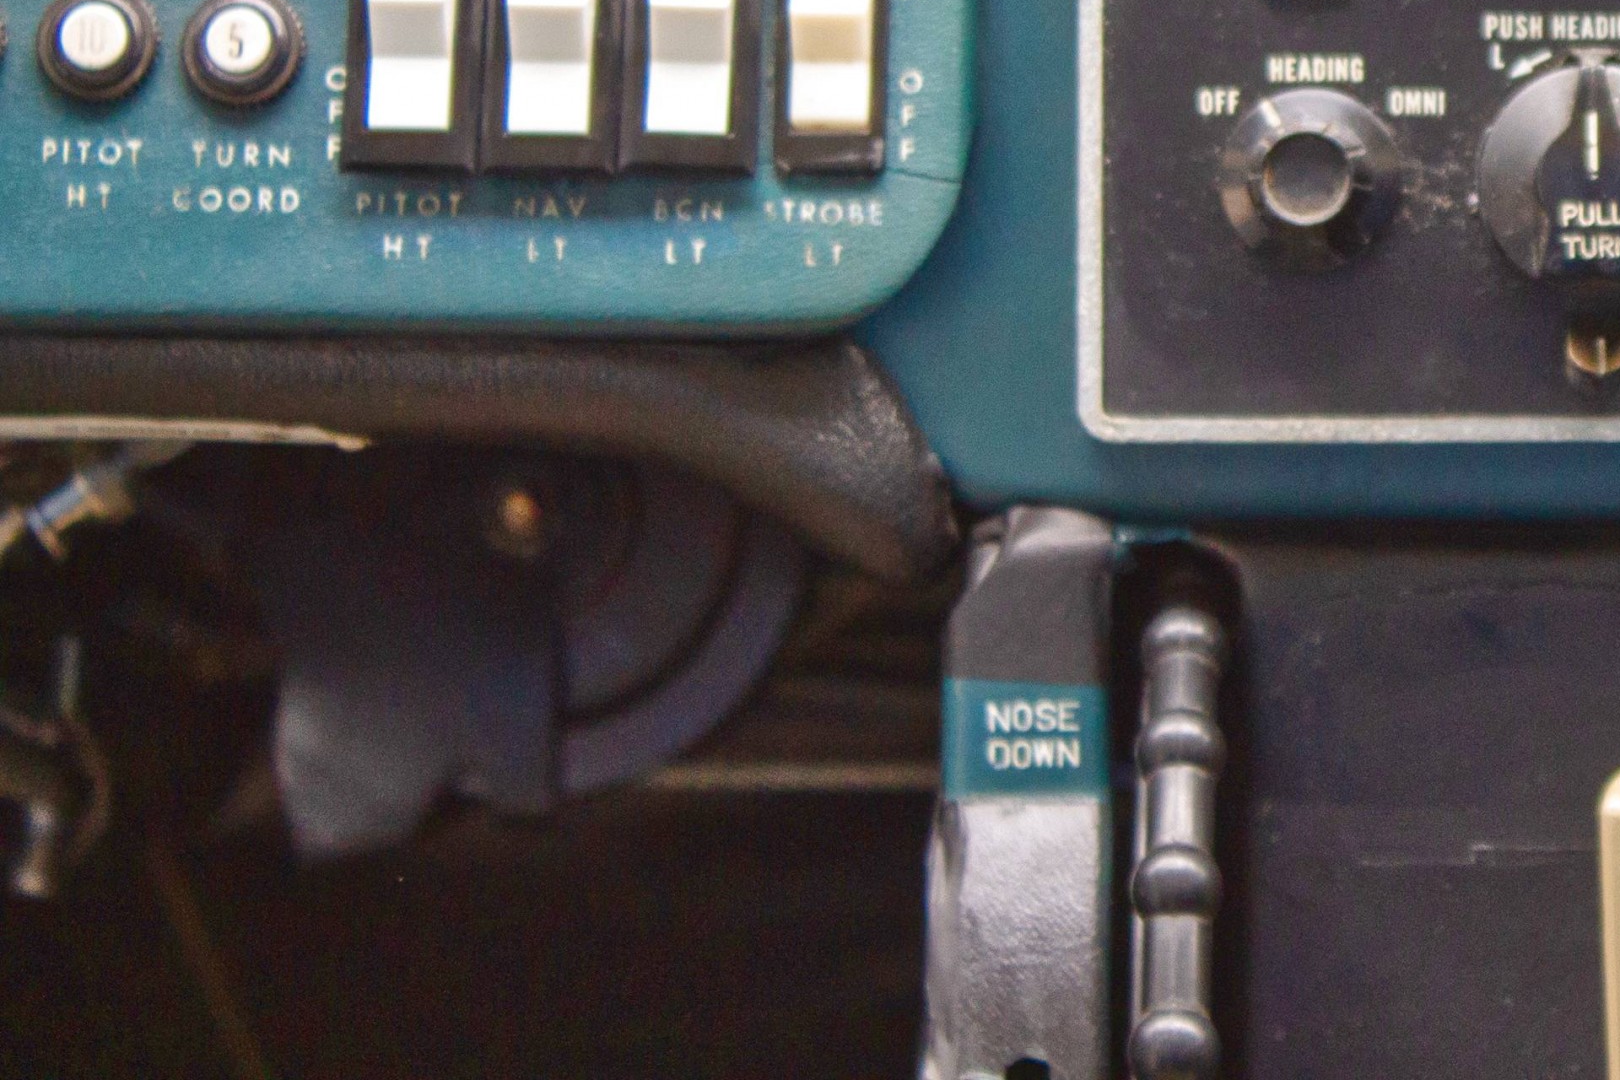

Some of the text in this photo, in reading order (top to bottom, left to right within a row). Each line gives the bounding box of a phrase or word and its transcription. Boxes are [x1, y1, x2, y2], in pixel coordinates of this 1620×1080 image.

[1482, 13, 1543, 40] PUSH
[228, 23, 245, 60] 5
[1268, 55, 1365, 83] HEADING
[1490, 46, 1505, 70] L
[1198, 89, 1240, 115] OFF
[1389, 89, 1447, 116] OMNI
[899, 70, 923, 163] OFF
[42, 139, 144, 167] PITOT
[192, 140, 292, 168] TURN
[67, 184, 112, 210] HT
[172, 187, 301, 214] COORD
[355, 191, 464, 216] PITOT
[514, 196, 587, 219] NAV
[763, 201, 884, 227] STROBE
[382, 234, 434, 261] HT
[526, 238, 568, 262] LT
[664, 240, 706, 265] LT
[803, 242, 844, 267] LT
[985, 699, 1081, 733] NOSE
[985, 739, 1082, 770] DOWN
